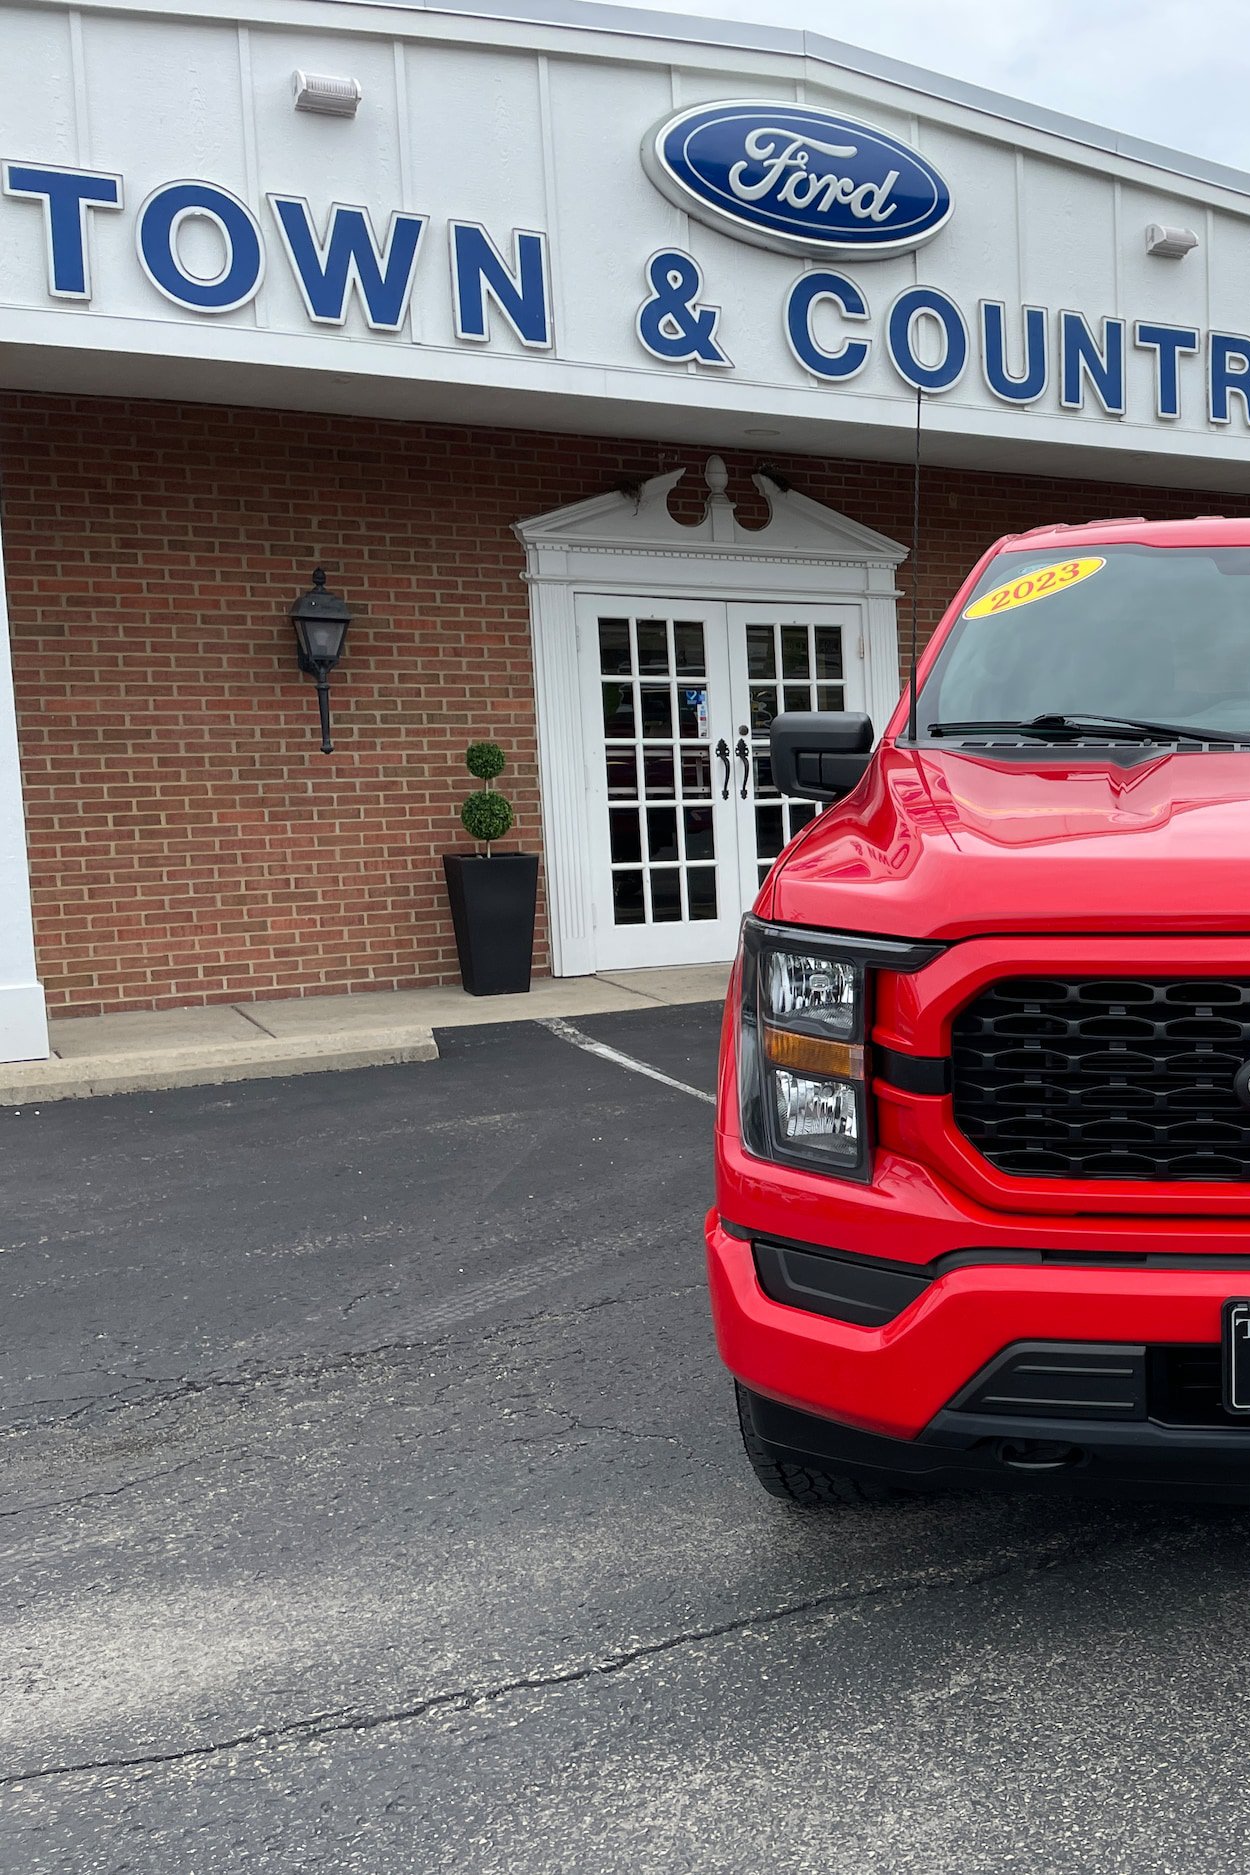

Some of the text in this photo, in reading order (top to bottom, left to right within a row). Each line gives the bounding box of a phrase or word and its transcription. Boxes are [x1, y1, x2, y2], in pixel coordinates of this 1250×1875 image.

[728, 127, 898, 223] Ford
[2, 159, 555, 350] TOWN
[636, 247, 734, 369] &
[991, 562, 1080, 611] 2023
